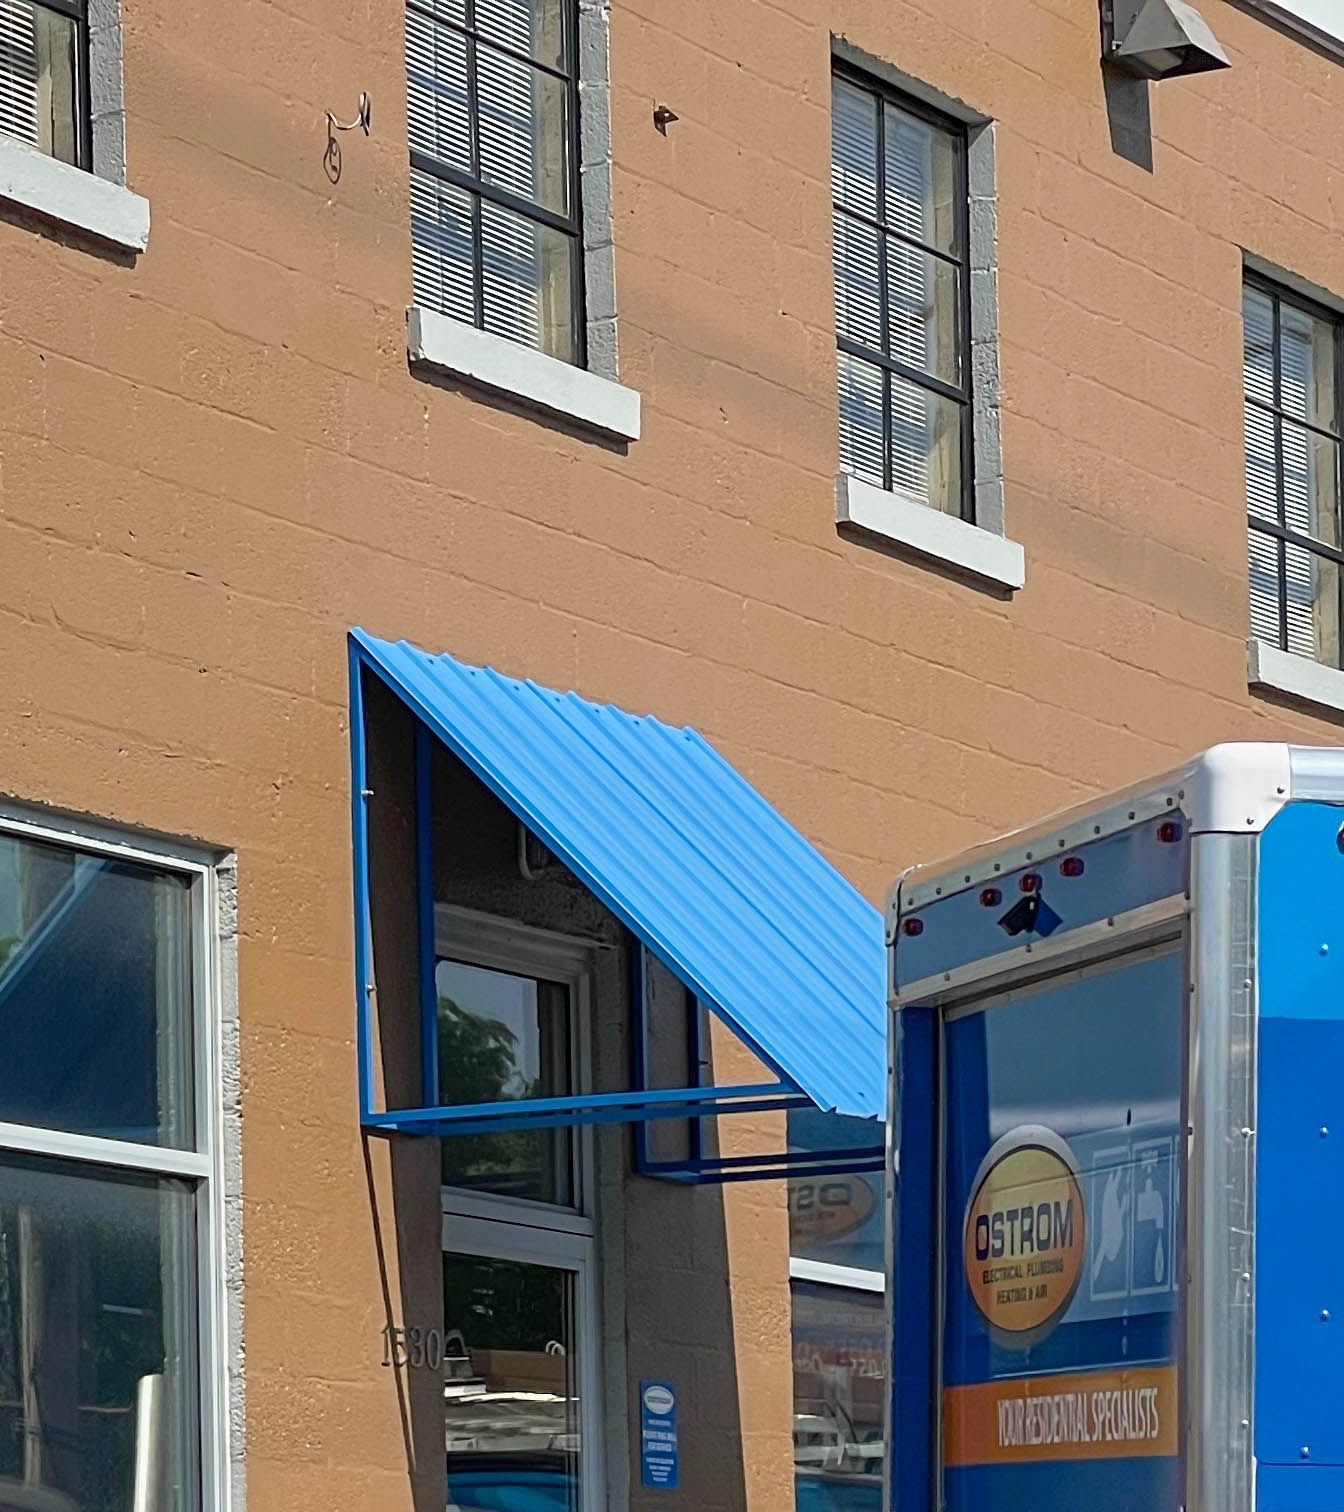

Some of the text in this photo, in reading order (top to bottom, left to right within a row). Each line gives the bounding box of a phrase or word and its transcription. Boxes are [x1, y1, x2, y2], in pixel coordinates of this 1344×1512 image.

[975, 1199, 1074, 1261] OSTROM
[997, 1386, 1159, 1447] YOUR RESIDENTIAL SPECIALISTS
